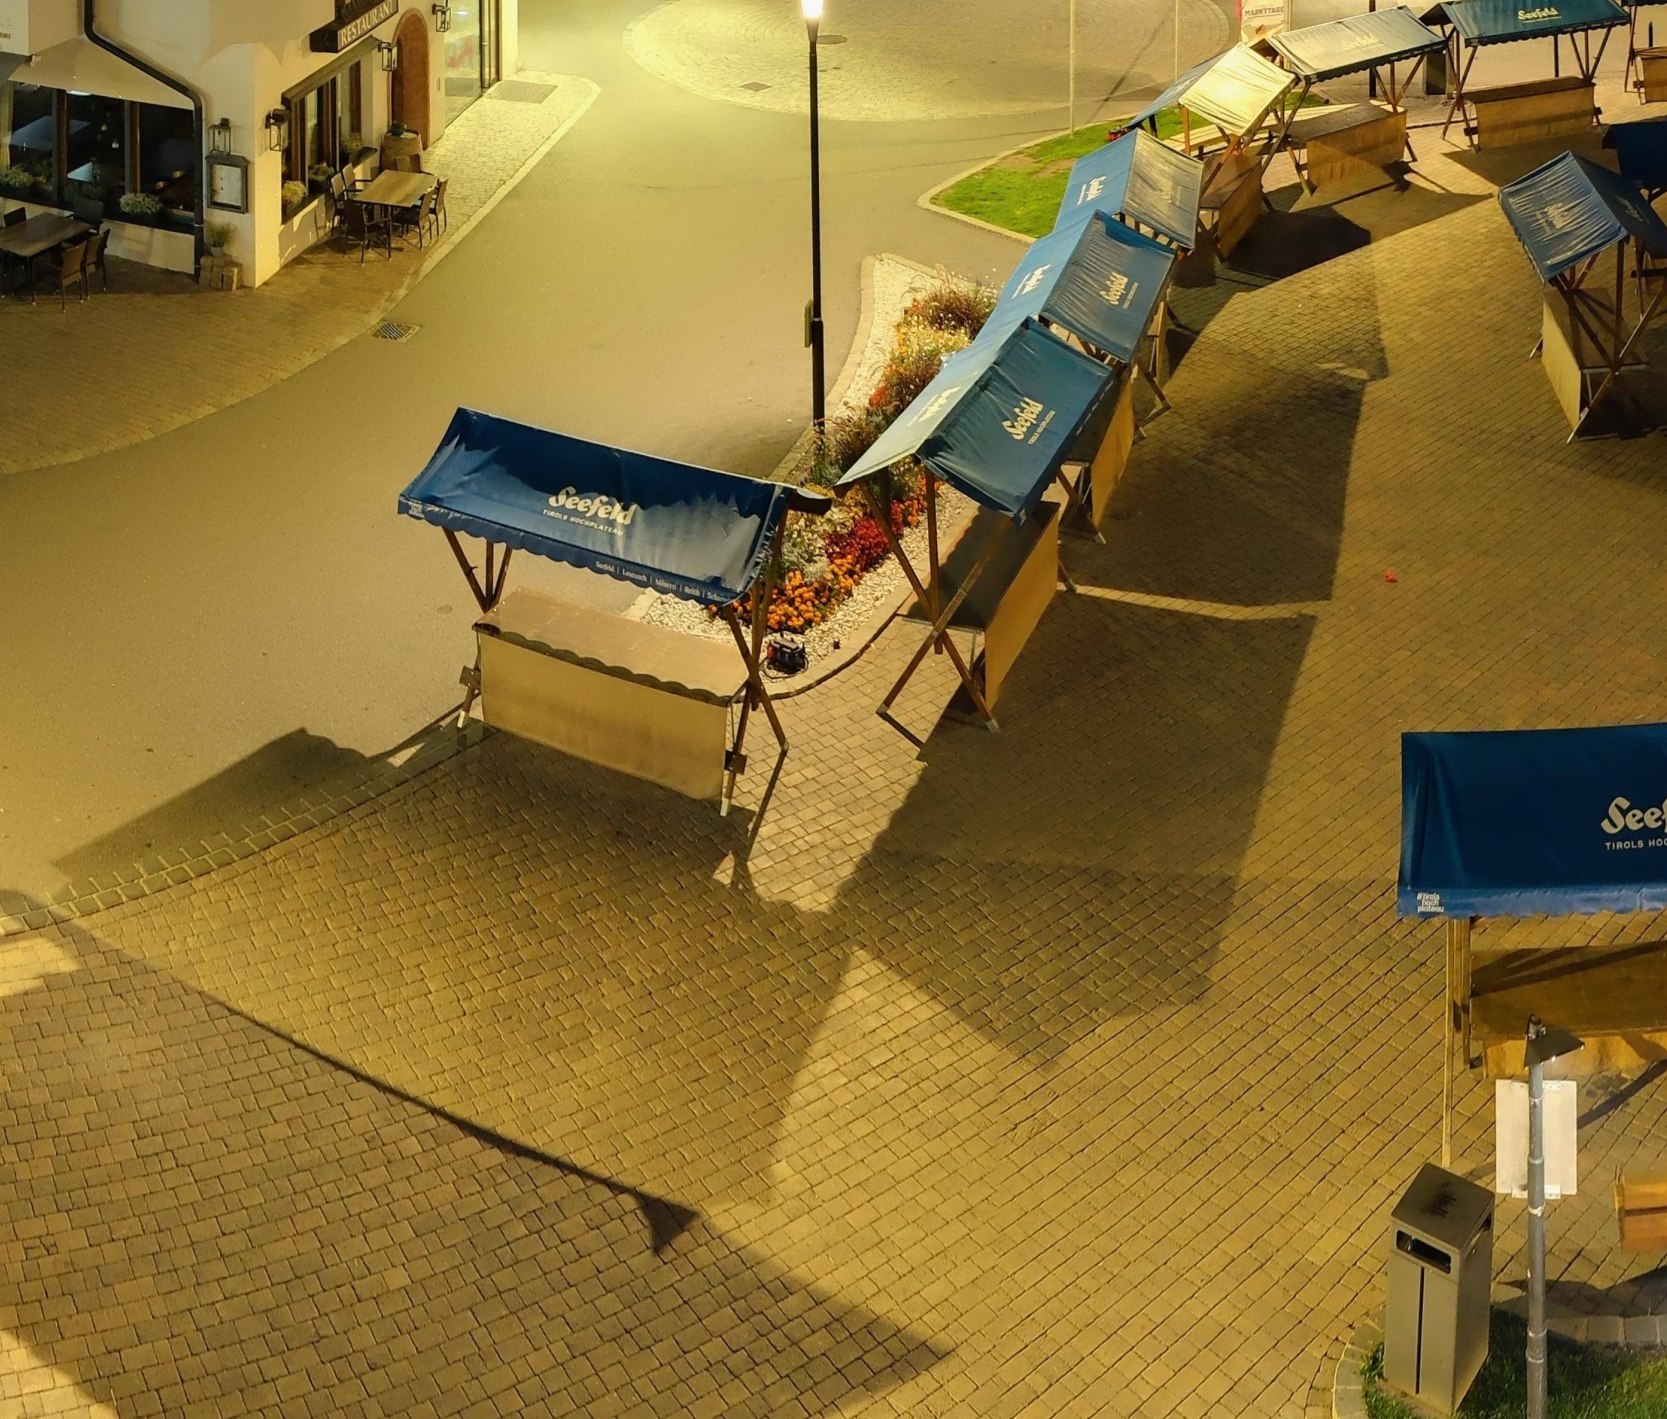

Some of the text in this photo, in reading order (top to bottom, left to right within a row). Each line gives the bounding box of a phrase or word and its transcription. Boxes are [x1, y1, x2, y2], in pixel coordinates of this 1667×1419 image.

[1002, 396, 1044, 441] Seefeld
[548, 485, 638, 525] Seefeld
[542, 509, 624, 536] TIROLS HOCHPLATEAU
[1605, 838, 1644, 851] TIROLS
